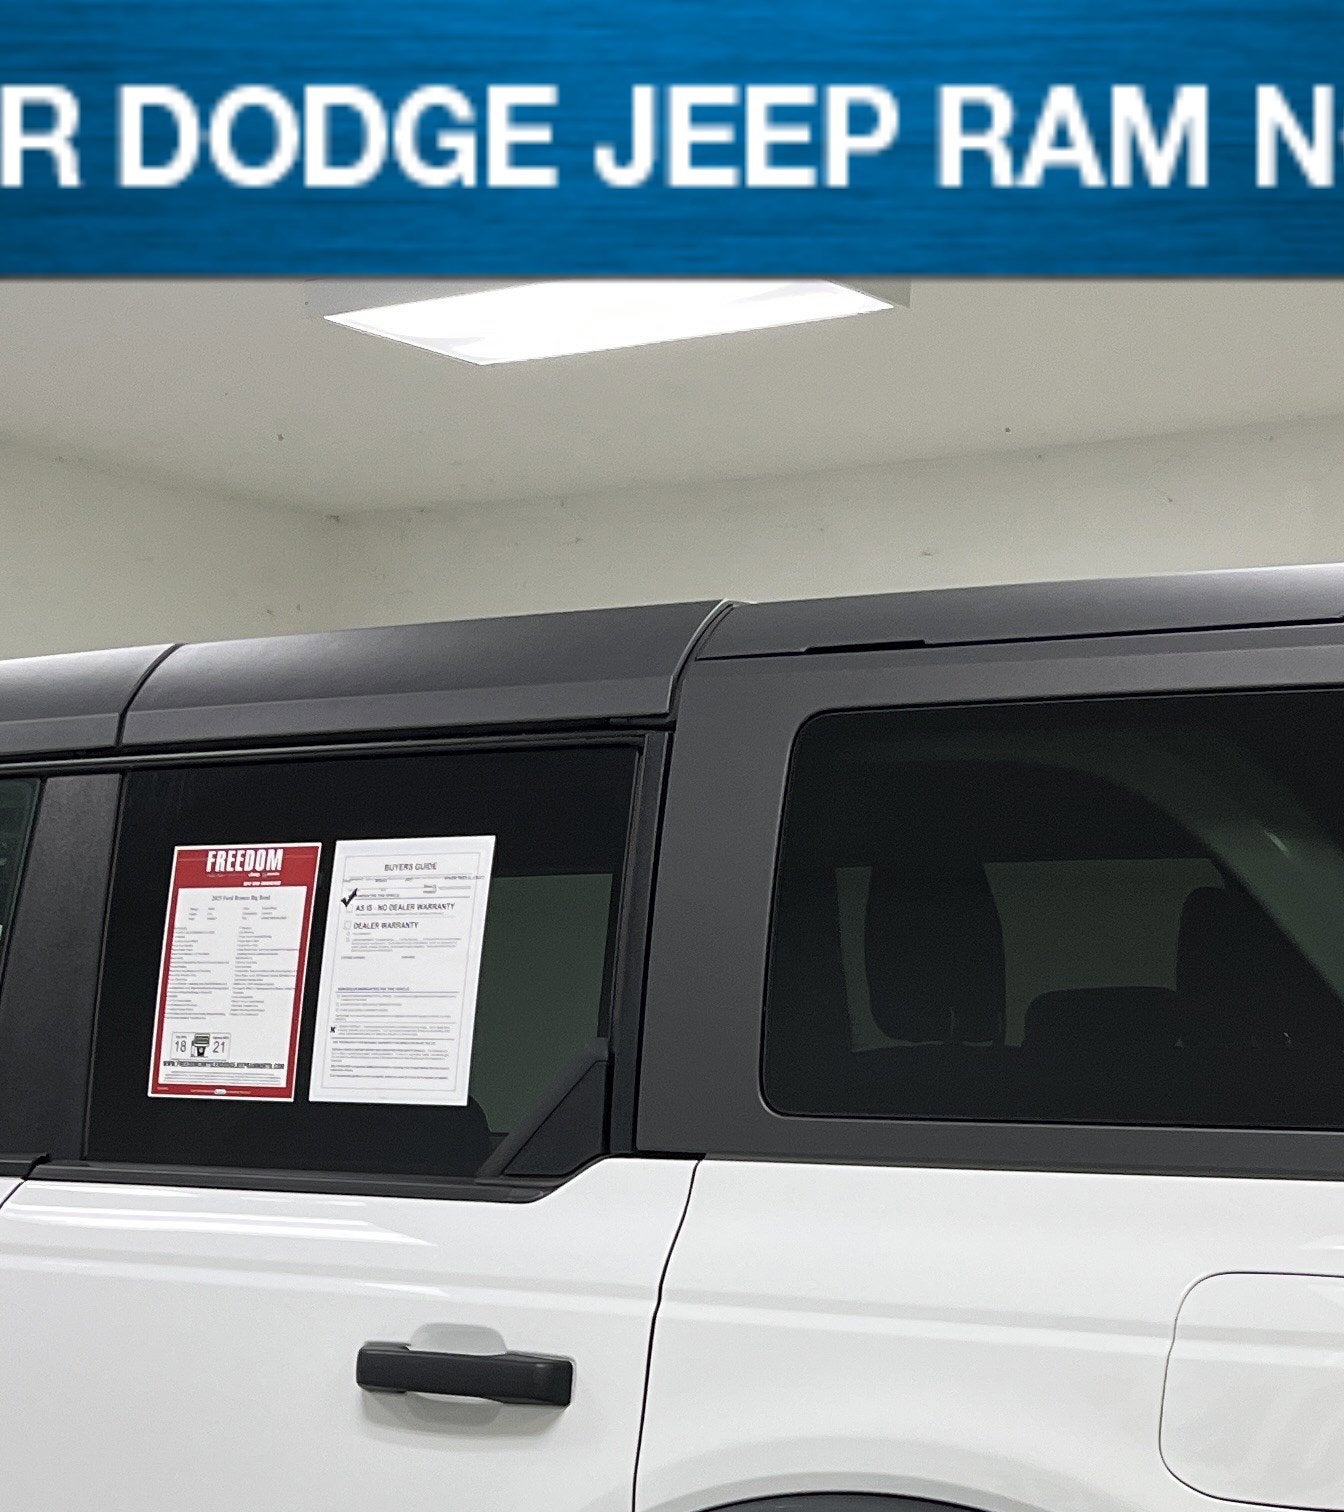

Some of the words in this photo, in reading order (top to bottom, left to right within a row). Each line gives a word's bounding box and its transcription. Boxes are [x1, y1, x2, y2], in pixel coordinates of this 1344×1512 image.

[205, 848, 284, 873] FREEDOM
[384, 862, 413, 872] BUYERS
[415, 862, 437, 871] GUIDE
[389, 903, 416, 911] DEALER
[417, 902, 455, 911] WARRANTY
[353, 922, 380, 930] DEALER
[381, 921, 419, 929] WARRANTY
[175, 1040, 187, 1053] 18
[212, 1041, 225, 1054] 21
